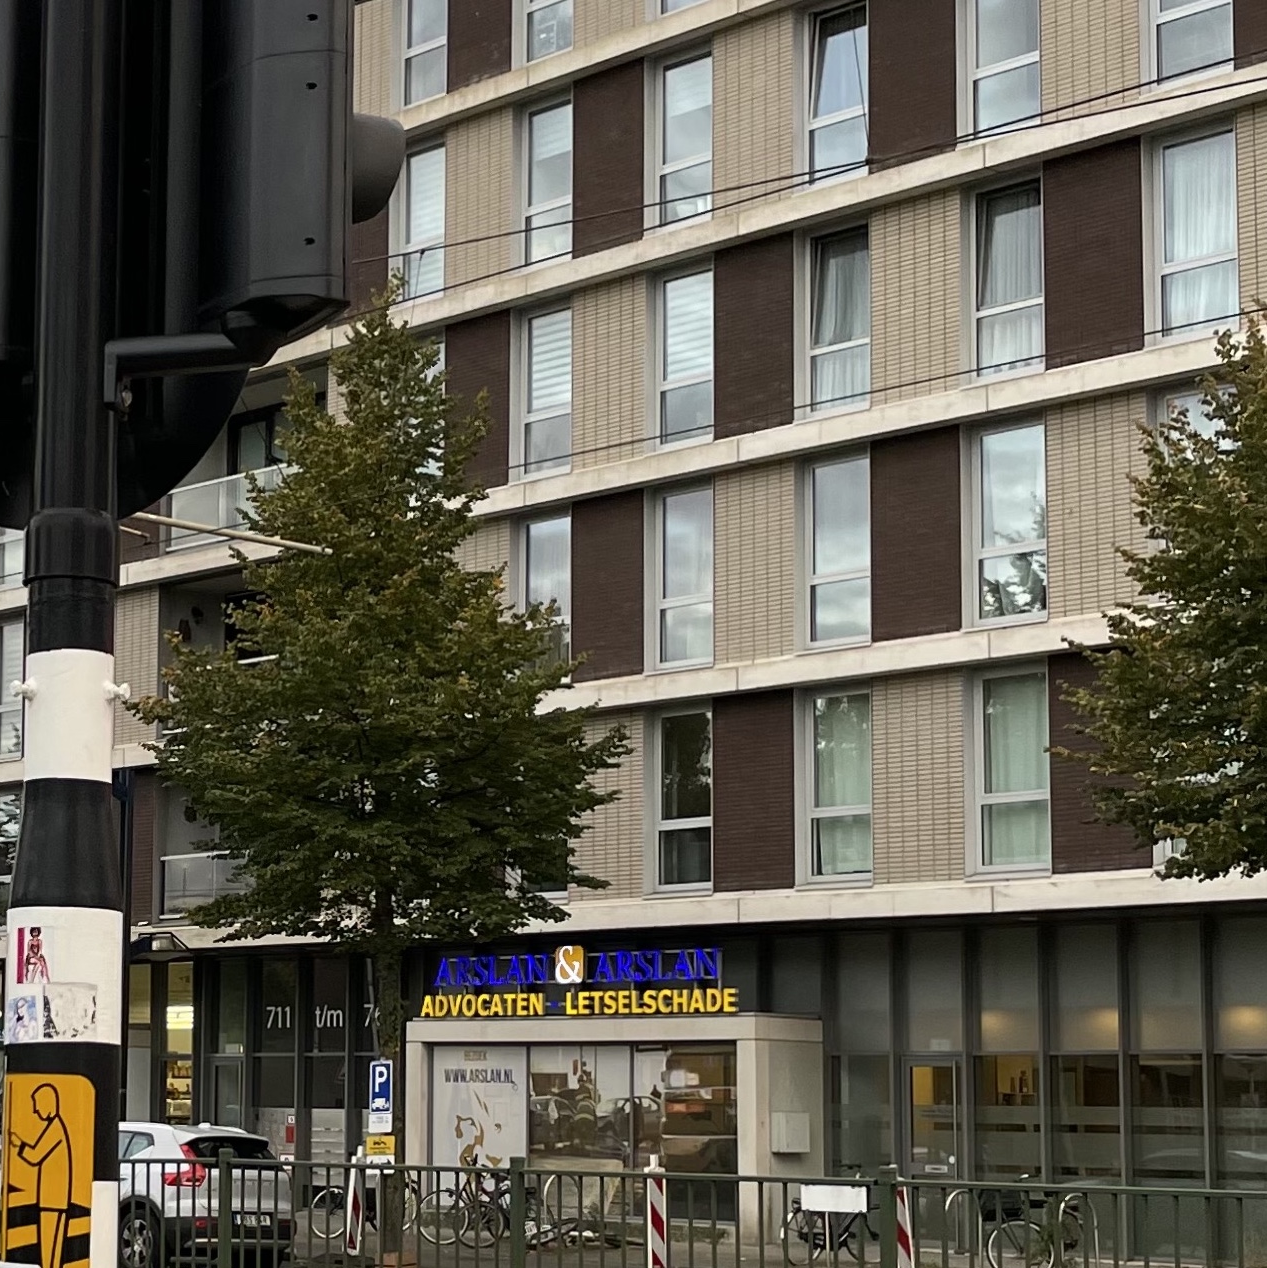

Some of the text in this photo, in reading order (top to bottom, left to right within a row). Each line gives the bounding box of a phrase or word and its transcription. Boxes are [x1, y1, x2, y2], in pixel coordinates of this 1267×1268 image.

[434, 946, 719, 986] ARSLAN & ARSLAN
[421, 988, 738, 1017] ADVOCATEN LETSELSCHADE
[266, 1006, 290, 1029] 711
[315, 1004, 343, 1028] t/m
[374, 1066, 387, 1092] P
[444, 1068, 513, 1083] WWW.ARSLAN.NL
